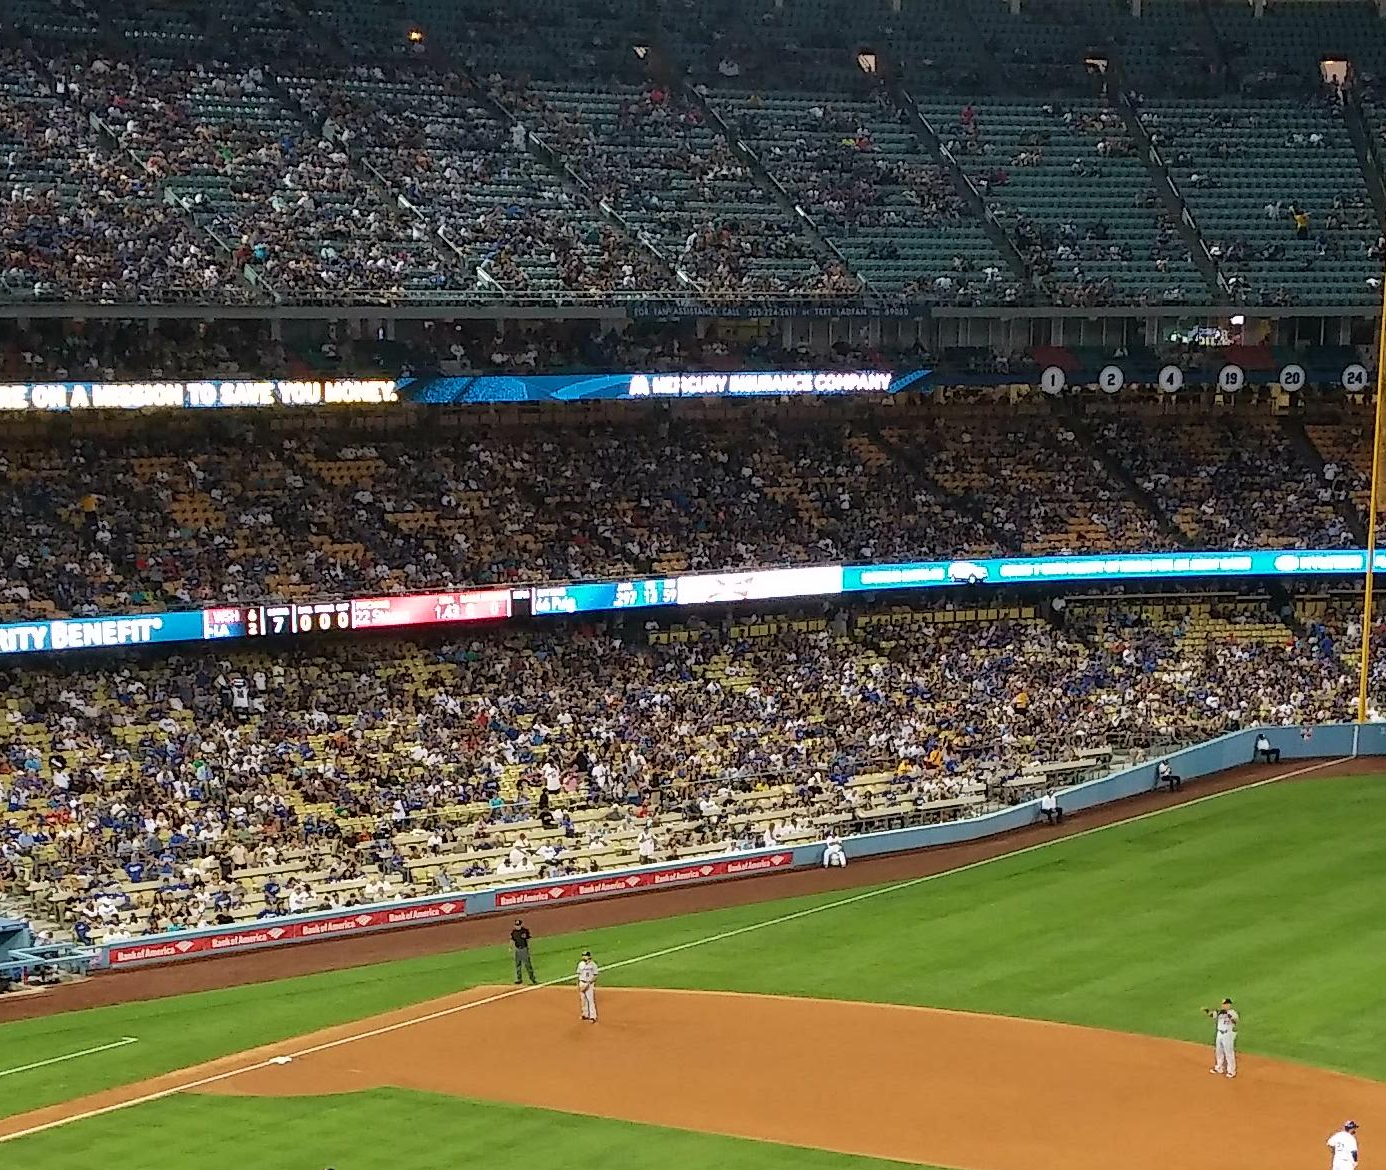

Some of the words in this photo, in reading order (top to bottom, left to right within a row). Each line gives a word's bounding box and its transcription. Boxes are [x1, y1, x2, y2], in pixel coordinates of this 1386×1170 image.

[814, 372, 893, 392] COMPANY
[1222, 371, 1240, 387] 19
[1281, 371, 1301, 387] 20
[1345, 371, 1364, 387] 24
[31, 384, 68, 409] ON
[69, 384, 90, 408] A
[91, 383, 184, 408] MISSION
[185, 382, 216, 406] TO
[218, 382, 275, 405] SAVE
[276, 381, 321, 405] YOU
[273, 616, 284, 633] 7
[300, 614, 312, 631] 0
[319, 612, 331, 630] 0
[337, 611, 349, 629] 0
[655, 874, 669, 883] Bank
[676, 870, 699, 880] America
[579, 885, 594, 894] Bank
[601, 882, 625, 891] America
[501, 896, 517, 906] Bank
[523, 892, 548, 903] America
[389, 911, 406, 922] Bank
[413, 908, 439, 919] America
[302, 924, 320, 935] Bank
[327, 920, 355, 932] America
[212, 936, 230, 948] Bank
[238, 932, 267, 945] America
[118, 949, 136, 961] Bank
[144, 945, 174, 957] America
